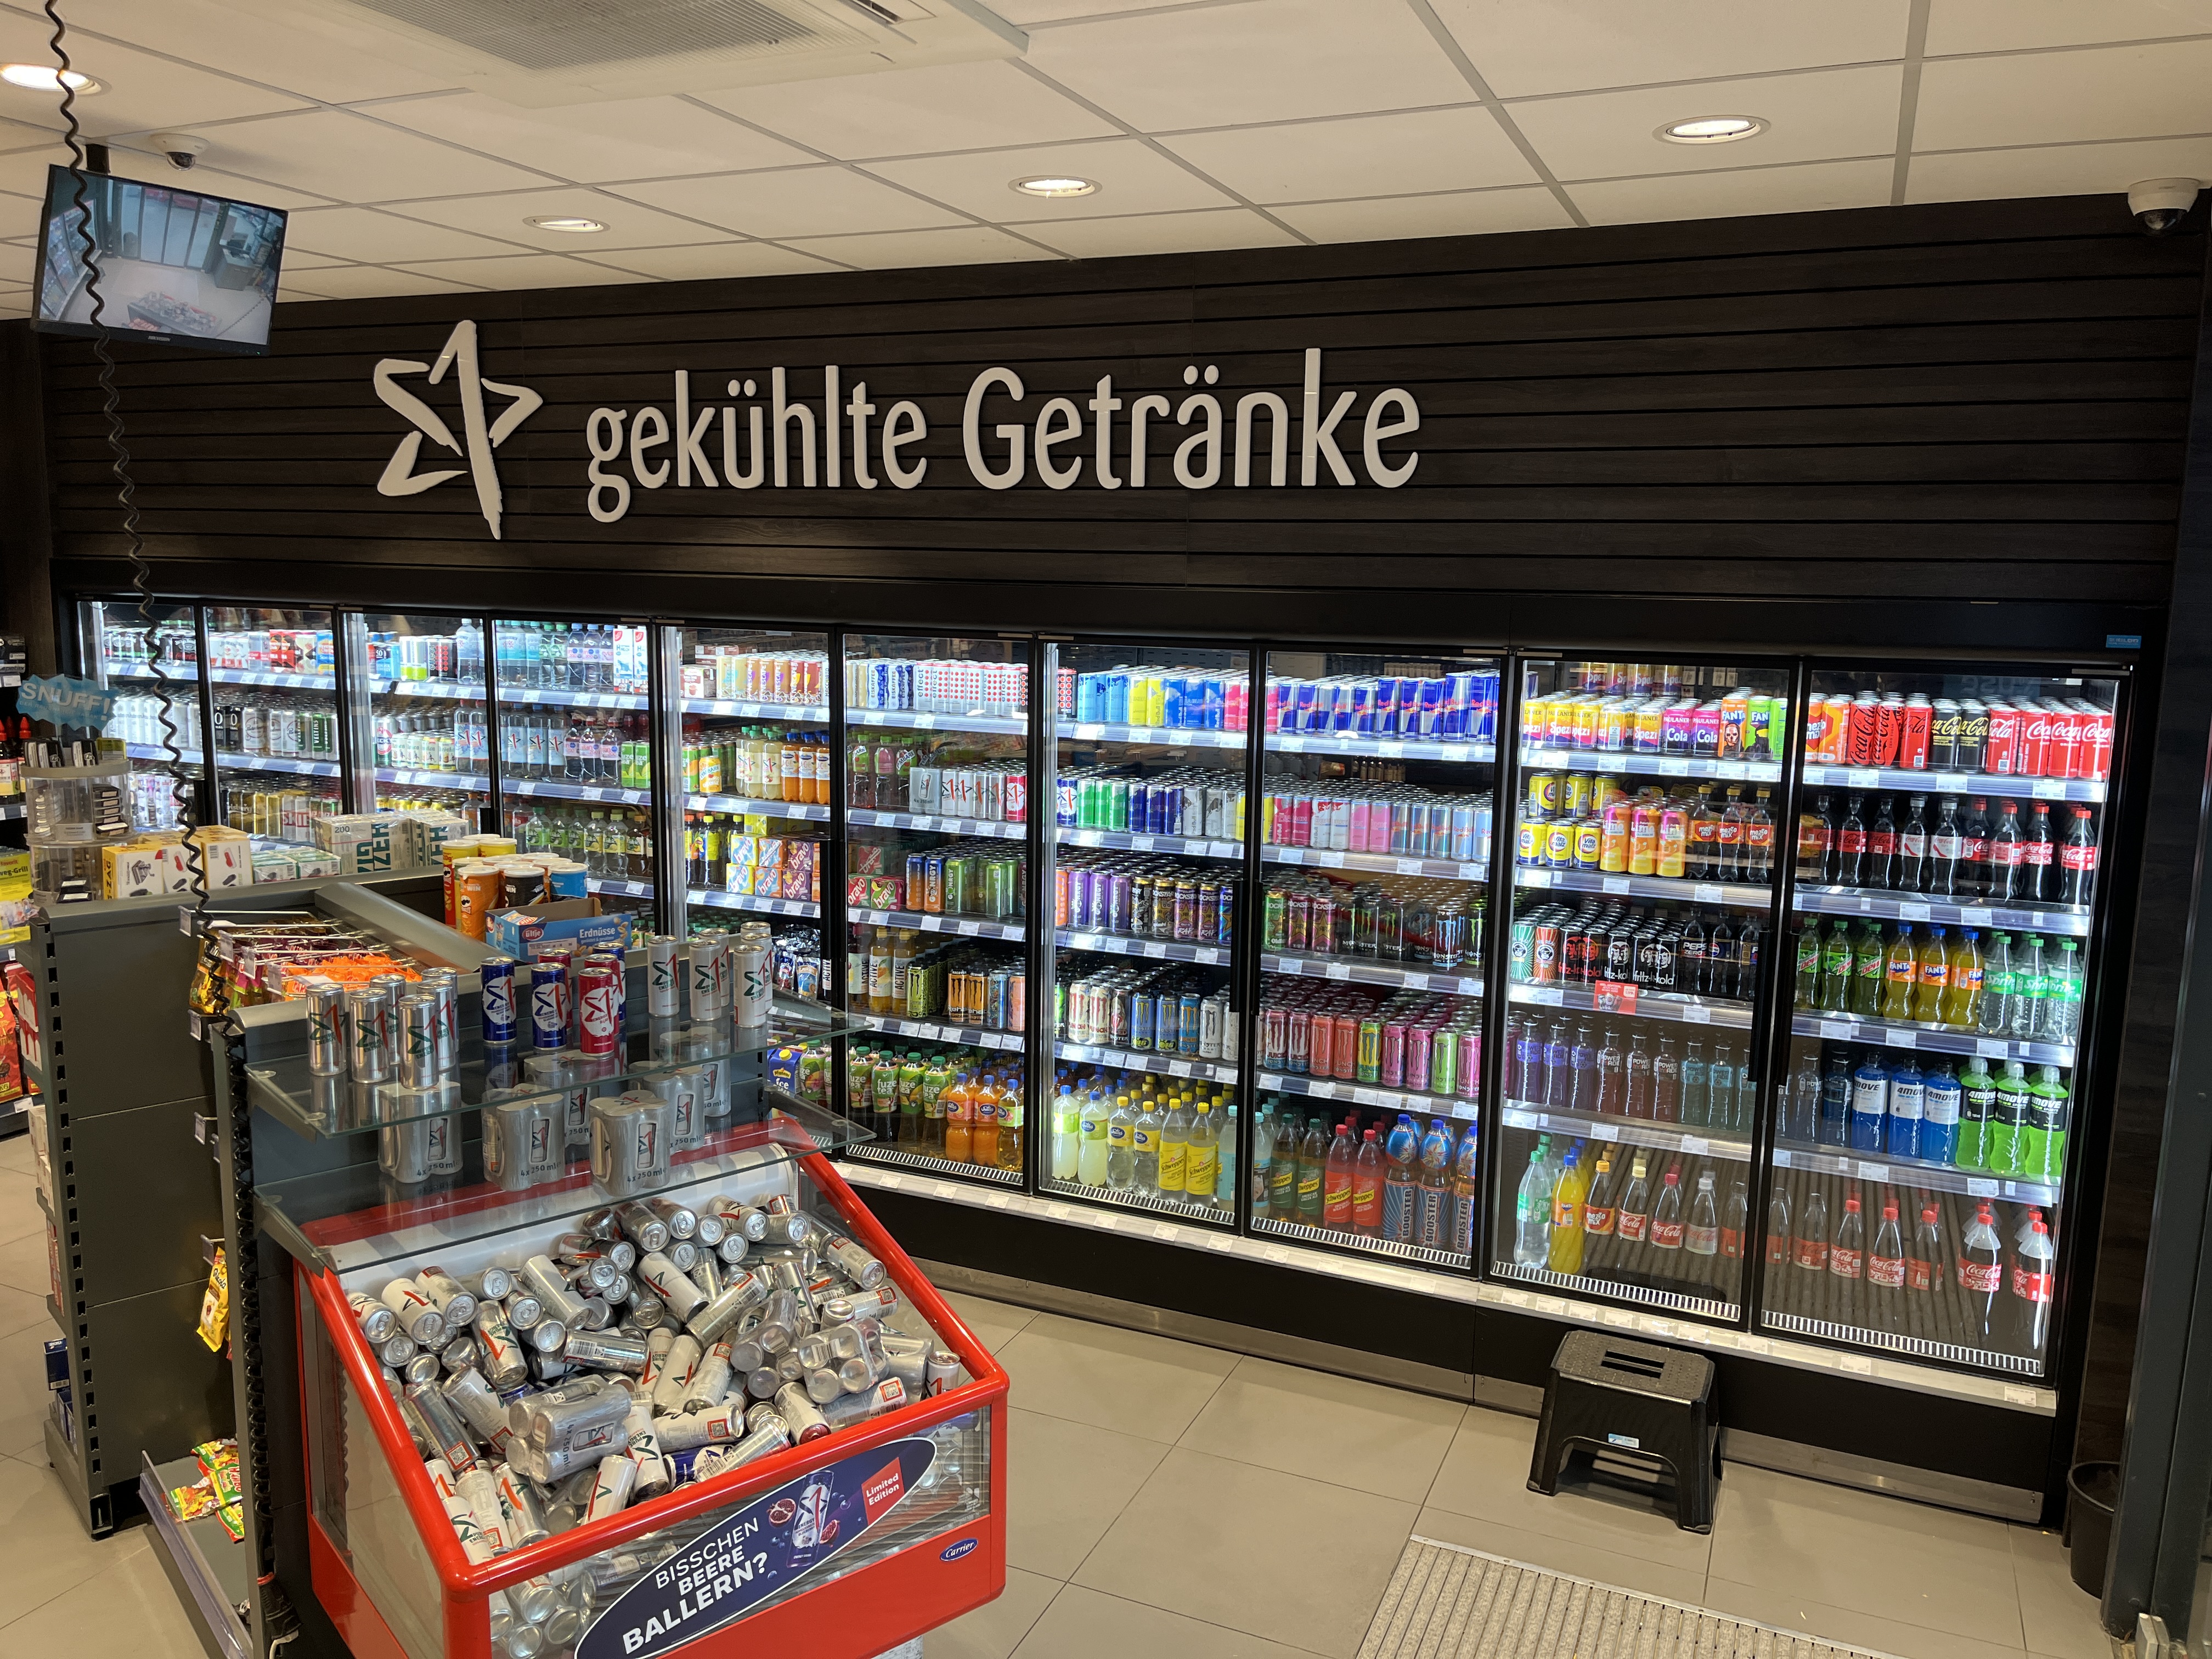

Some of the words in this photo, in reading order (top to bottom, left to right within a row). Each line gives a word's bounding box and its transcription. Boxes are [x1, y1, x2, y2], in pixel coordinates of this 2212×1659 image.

[585, 364, 928, 524] gekühlte
[961, 347, 1421, 490] Getränke
[1588, 672, 1606, 682] Spezi
[21, 682, 111, 721] SNUFF!
[1722, 710, 1746, 720] FANTA
[1550, 722, 1572, 735] Spezi
[1634, 726, 1657, 739] Spezi
[1667, 727, 1688, 742] Cola
[1697, 729, 1718, 743] Cola
[1850, 704, 1876, 765] Coca-Cola
[2083, 723, 2111, 742] Coca
[1632, 823, 1655, 834] Limo
[1551, 840, 1566, 849] malz
[1554, 835, 1565, 843] Vita
[733, 838, 752, 864] bravo
[790, 842, 809, 870] bravo
[2024, 843, 2052, 854] Coca-Cola
[729, 866, 748, 893] bravo
[757, 868, 777, 896] bravo
[785, 872, 805, 900] bravo
[848, 878, 866, 905] bravo
[873, 881, 895, 910] bravo
[525, 929, 541, 939] ültje
[579, 927, 616, 939] Erdnüsse
[1800, 956, 1819, 970] DEW
[1861, 958, 1881, 975] DEW
[1889, 961, 1910, 972] FANTA
[869, 963, 877, 988] ACTIVE
[894, 965, 904, 990] ACTIVE
[1925, 965, 1946, 977] FANTA
[776, 1077, 789, 1090] ice
[878, 1079, 897, 1088] fuze
[878, 1086, 894, 1095] tea
[899, 1078, 916, 1089] fuze
[923, 1082, 940, 1093] fuze
[923, 1091, 936, 1100] tea
[1928, 1092, 1959, 1103] 4MOVE
[1997, 1092, 2029, 1103] 4MOVE
[568, 1127, 583, 1136] 250
[675, 1137, 689, 1146] 250
[427, 1162, 445, 1172] 250
[531, 1164, 548, 1173] 250
[1161, 1158, 1185, 1173] Schweppes
[1189, 1162, 1214, 1177] Schweppes
[637, 1170, 653, 1180] 250
[1325, 1188, 1352, 1204] Schweppes
[1402, 1188, 1413, 1238] BOOSTER
[1425, 1194, 1437, 1243] BOOSTER
[1586, 1212, 1606, 1221] mezzo
[1457, 1200, 1469, 1250] BOOSTER
[1651, 1221, 1681, 1238] Coca-Cola
[1869, 1256, 1901, 1273] Coca-Cola
[1966, 1263, 2001, 1280] Coca-Cola
[562, 1436, 571, 1453] 250
[866, 1472, 899, 1498] Limited
[868, 1483, 900, 1506] Edition
[655, 1517, 759, 1589] BISSCHEN
[945, 1541, 975, 1558] Carrier
[678, 1545, 745, 1595] BEERE
[623, 1552, 768, 1655] BALLERN?
